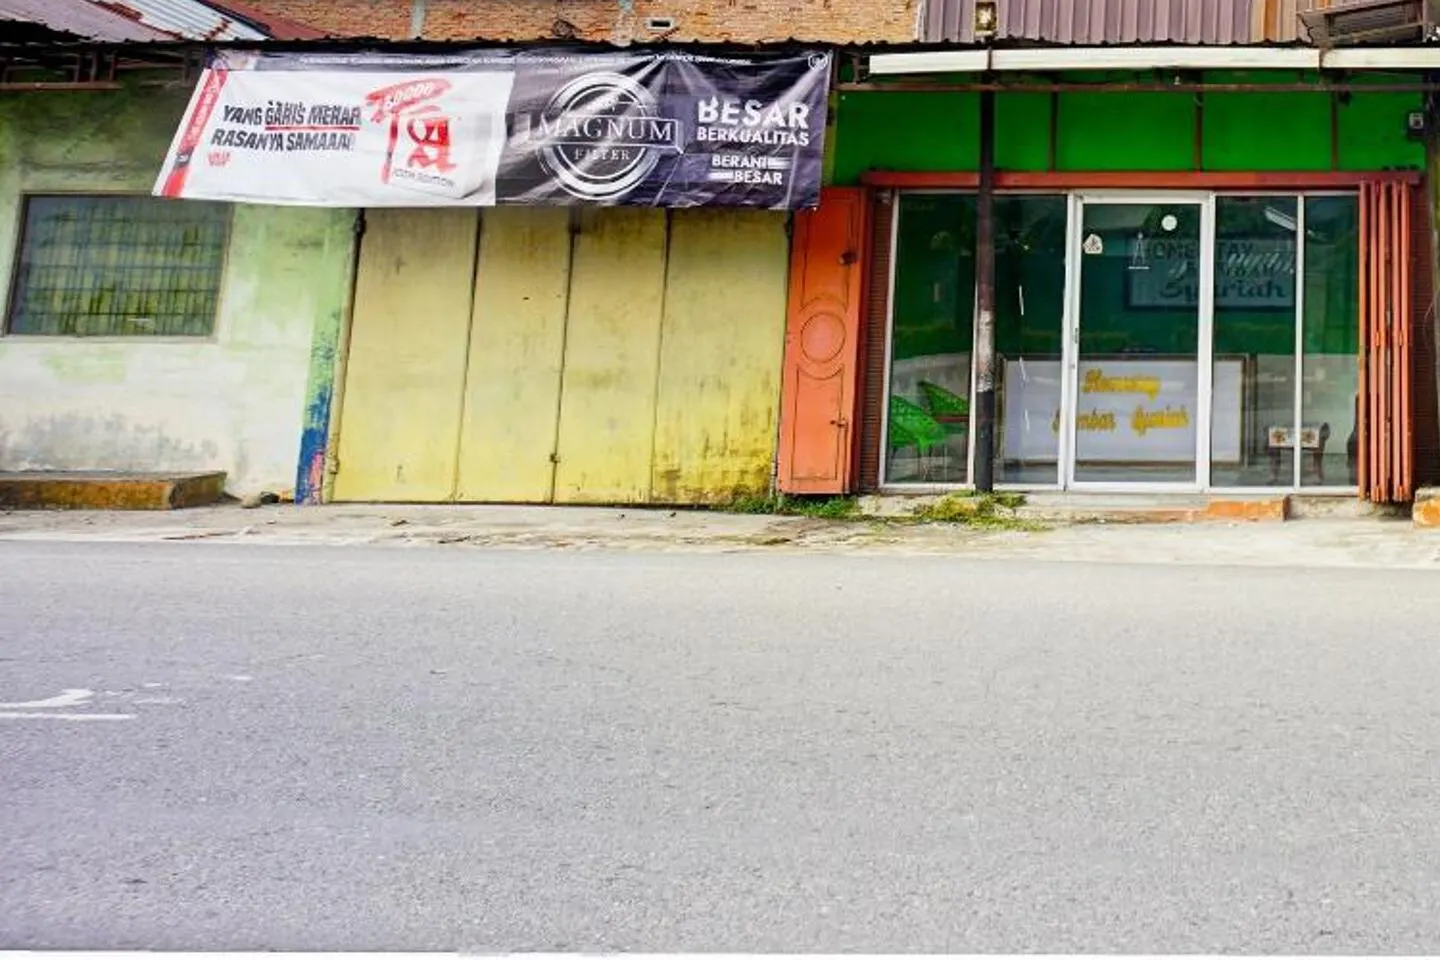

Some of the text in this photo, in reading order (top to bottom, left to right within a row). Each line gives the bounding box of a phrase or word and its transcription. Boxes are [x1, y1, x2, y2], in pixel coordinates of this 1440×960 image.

[223, 104, 262, 126] YANG
[265, 101, 306, 125] GARIS
[697, 96, 810, 129] BESAR
[538, 114, 673, 141] MAGNUM
[696, 126, 810, 147] BERKUALITAS
[210, 128, 284, 152] RASANYA
[573, 148, 631, 161] FILTER
[712, 154, 769, 169] BERANI
[733, 170, 783, 186] BESAR
